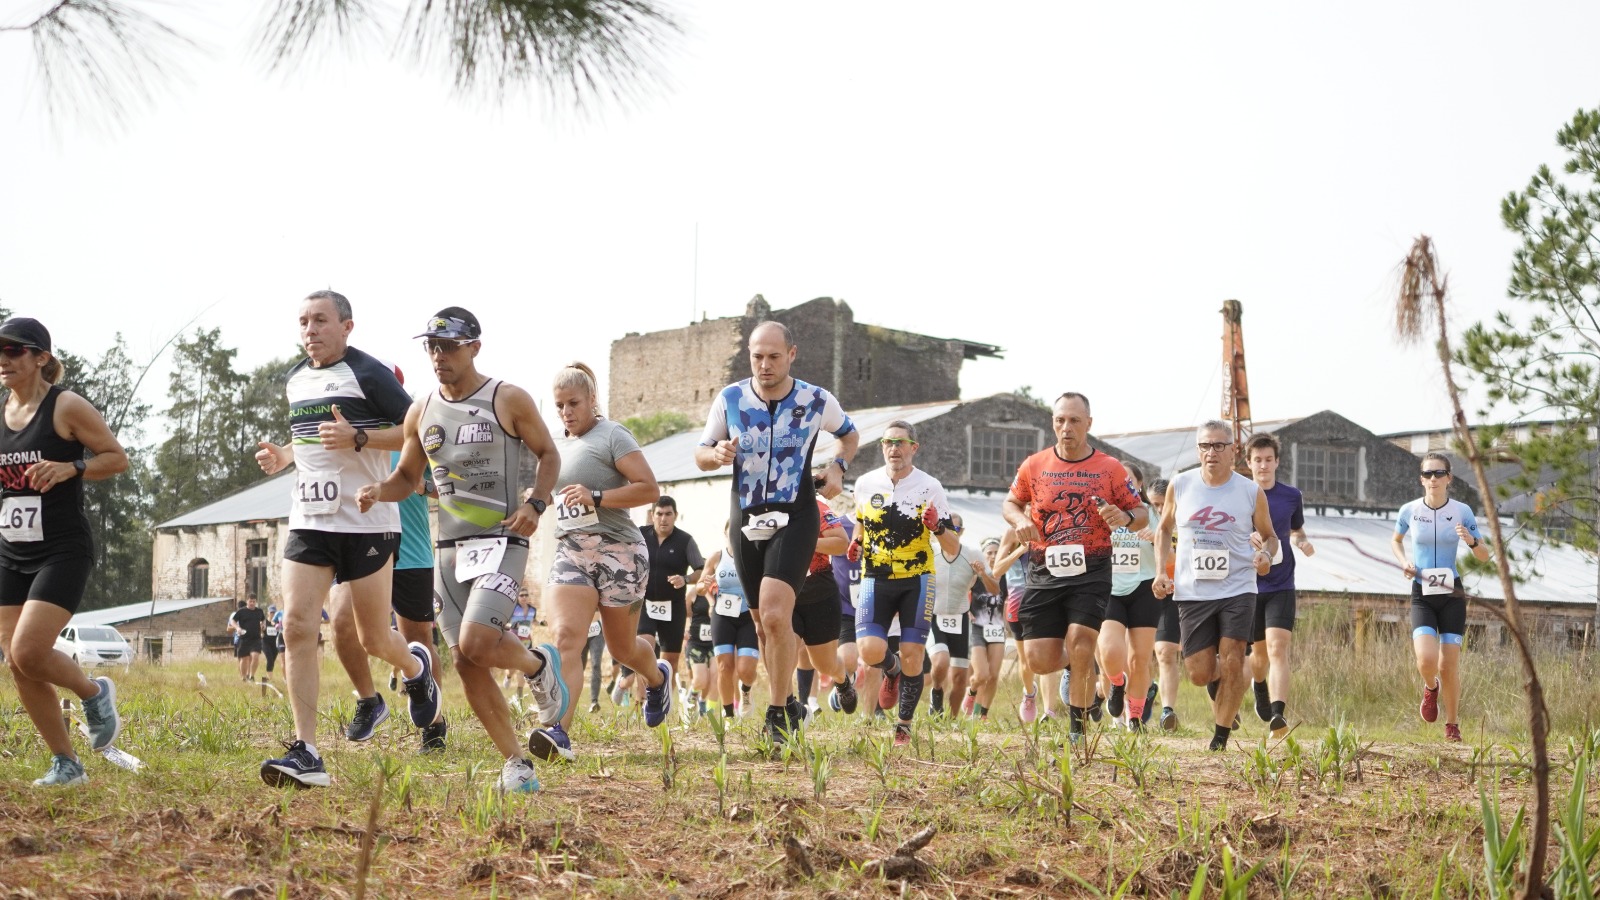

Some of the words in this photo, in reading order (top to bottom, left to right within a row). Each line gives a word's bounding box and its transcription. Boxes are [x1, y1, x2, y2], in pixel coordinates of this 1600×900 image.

[757, 434, 804, 448] Nkaia
[1042, 471, 1074, 479] Proyecto
[1076, 471, 1101, 479] Bikers
[300, 481, 339, 502] 110
[0, 507, 38, 529] 167
[466, 547, 494, 568] 37
[1047, 552, 1084, 568] 156
[1111, 554, 1139, 566] 125
[1194, 556, 1228, 571] 102
[1428, 574, 1447, 588] 27
[923, 571, 936, 623] ARGENTIN
[651, 604, 667, 615] 26
[724, 600, 732, 610] 9
[590, 624, 600, 633] 09
[942, 618, 957, 628] 53
[985, 628, 1004, 638] 162
